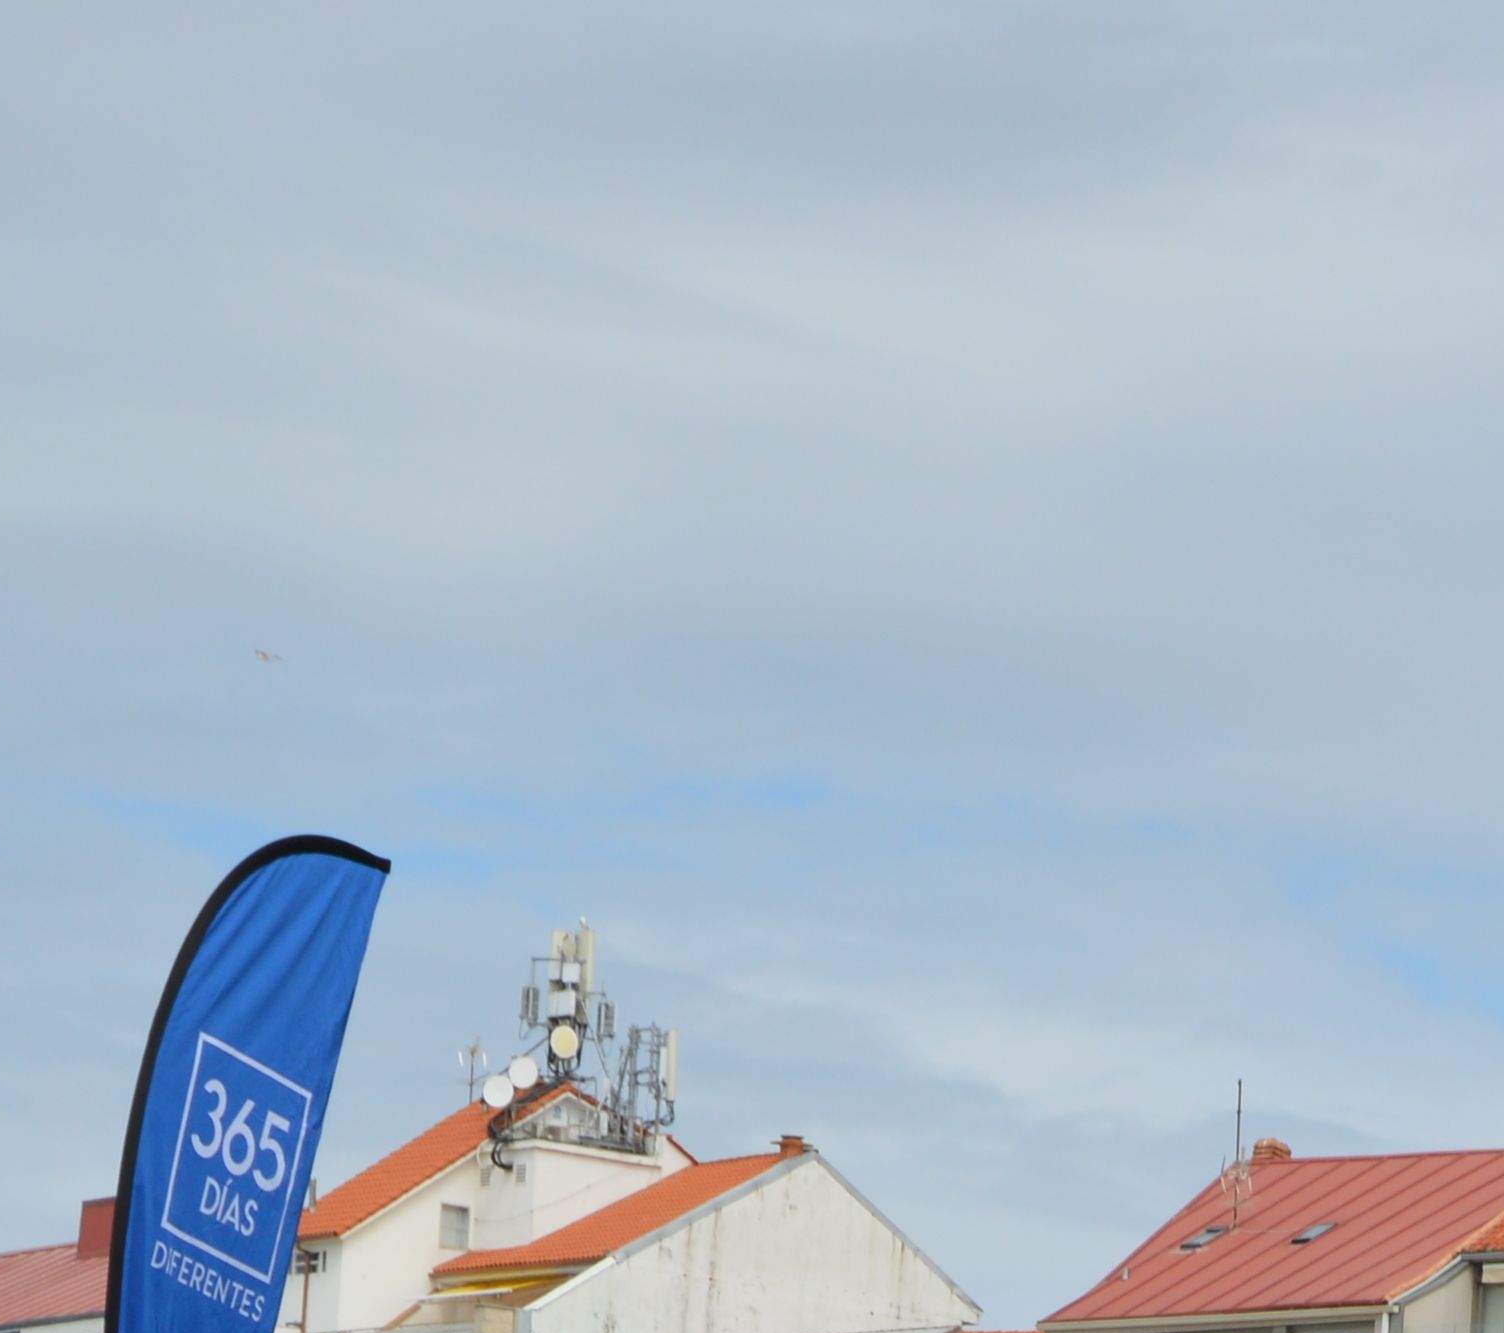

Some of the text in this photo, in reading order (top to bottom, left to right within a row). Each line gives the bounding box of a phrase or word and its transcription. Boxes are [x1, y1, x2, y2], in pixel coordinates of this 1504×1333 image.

[191, 1079, 292, 1193] 365
[199, 1176, 259, 1237] DÍAS
[150, 1241, 266, 1323] DIFERENTES
